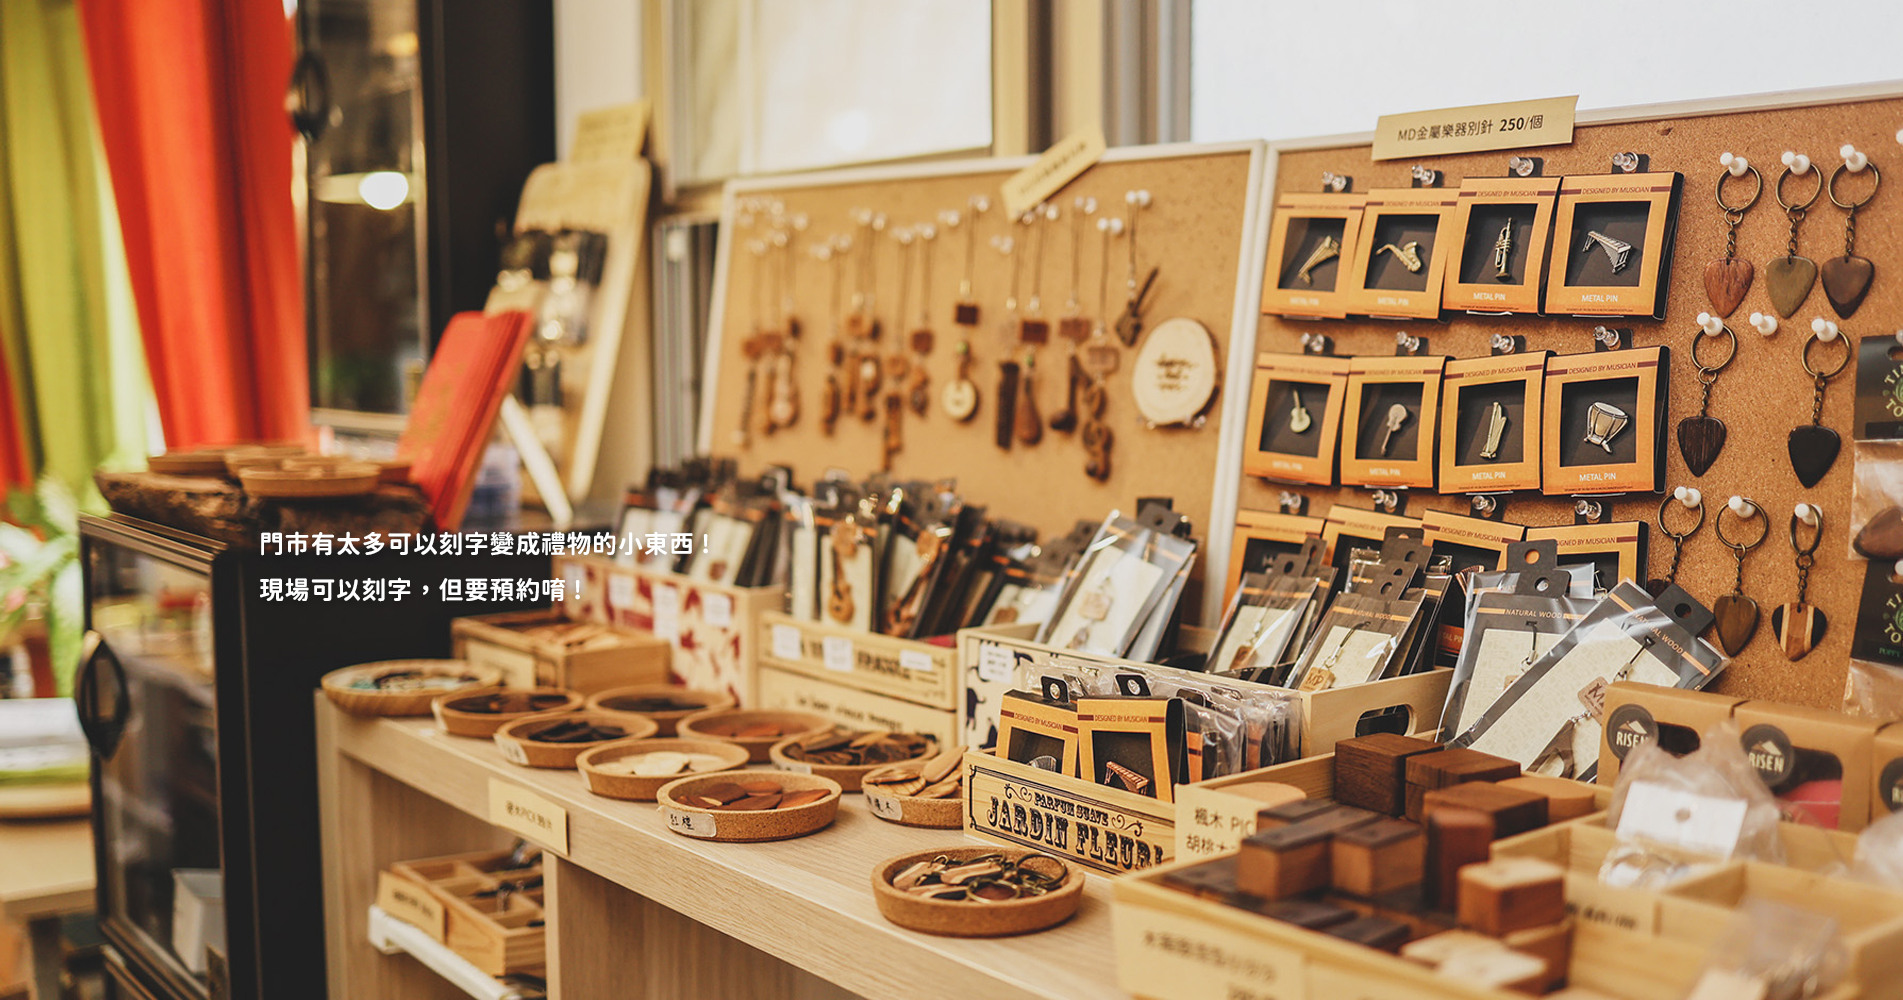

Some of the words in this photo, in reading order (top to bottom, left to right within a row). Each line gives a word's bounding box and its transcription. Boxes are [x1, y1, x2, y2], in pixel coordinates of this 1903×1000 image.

[1499, 114, 1543, 132] 250/個
[1477, 190, 1501, 198] DESIGNED
[1582, 187, 1610, 195] DESIGNED
[1620, 186, 1650, 194] MUSICIAN
[1473, 292, 1494, 300] METAL
[1495, 292, 1506, 301] PIN
[1581, 294, 1604, 302] METAL
[1605, 294, 1618, 302] PIN
[1465, 370, 1490, 378] DESIGNED
[1498, 366, 1526, 375] MUSICIAN
[1568, 366, 1596, 374] DESIGNED
[1597, 364, 1606, 372] BY
[1606, 362, 1637, 370] MUSICIAN
[1472, 472, 1493, 480] METAL
[1494, 471, 1506, 479] PIN
[1579, 473, 1601, 481] METAL
[1602, 472, 1616, 480] PIN
[1441, 526, 1466, 537] DESIGNED
[1467, 530, 1474, 538] BY
[1474, 531, 1501, 542] MUSICIAN
[1577, 538, 1585, 546] BY
[1585, 537, 1616, 545] MUSICIAN
[1505, 608, 1537, 618] NATURAL
[1538, 611, 1562, 619] WOOD
[1661, 634, 1684, 654] WOOD
[1014, 712, 1035, 723] DESIGNED
[1035, 717, 1041, 725] BY
[1041, 719, 1062, 730] MUSICIAN
[1094, 714, 1117, 722] DESIGNED
[1749, 752, 1784, 772] RISEN
[1034, 791, 1075, 817] PARFUM
[1076, 804, 1109, 826] SUAVE
[987, 795, 1069, 850] JARDIN
